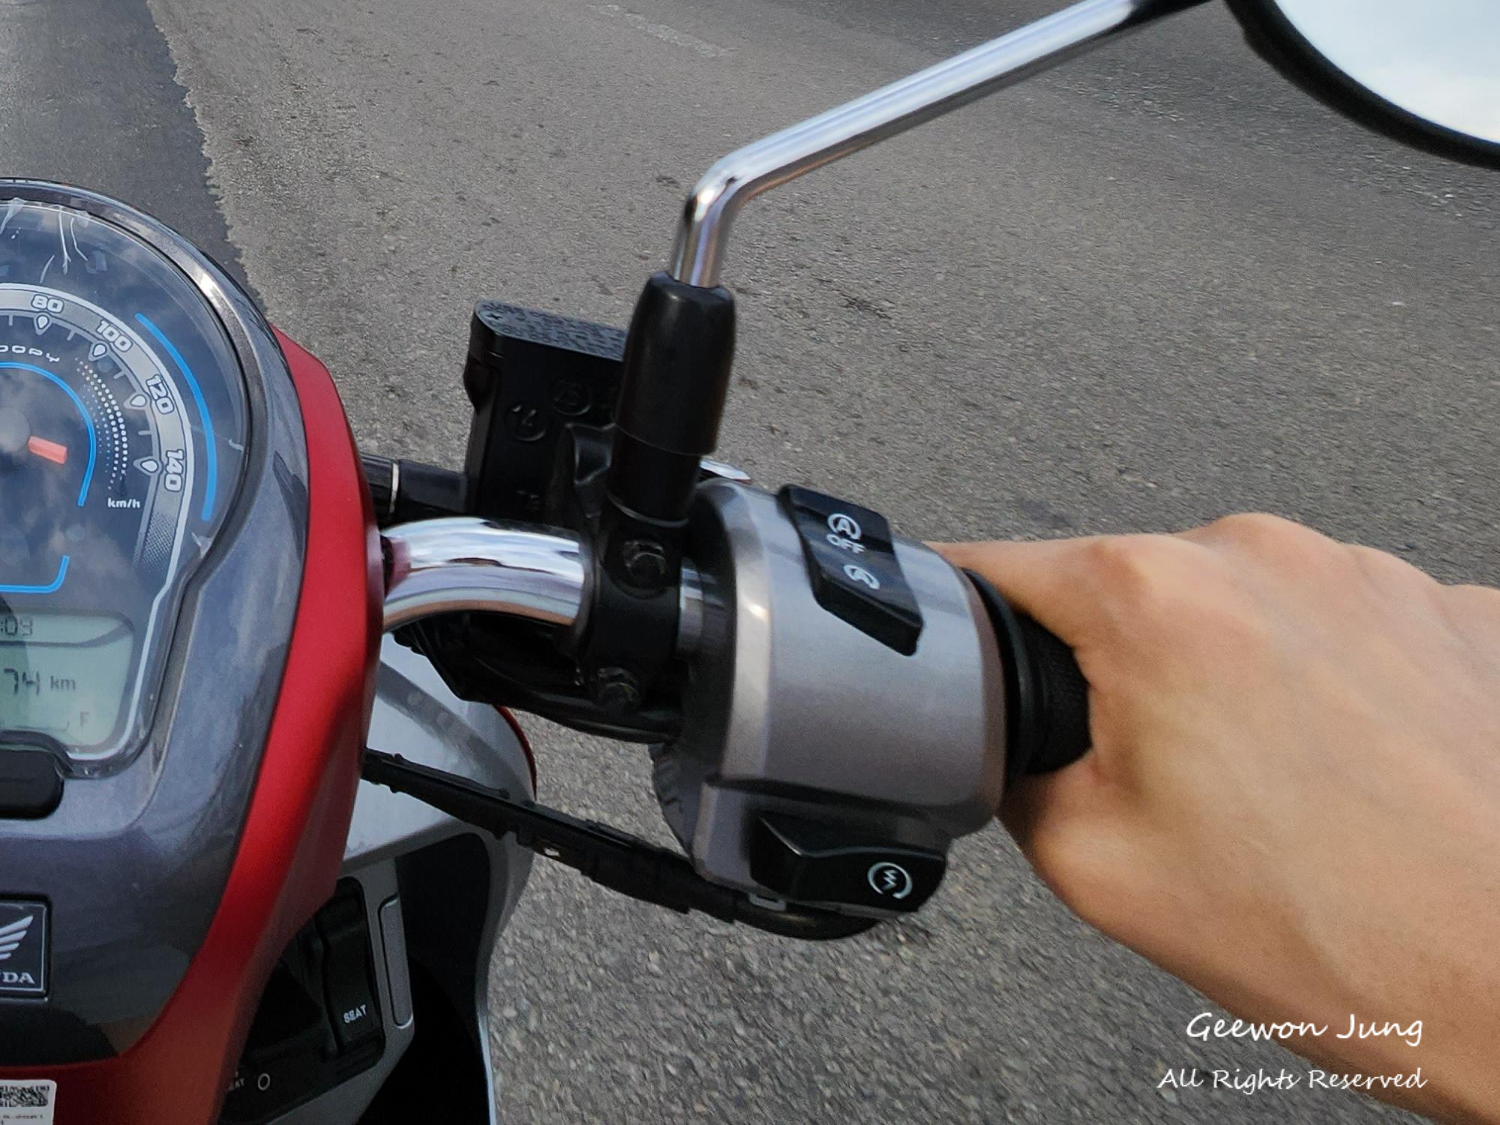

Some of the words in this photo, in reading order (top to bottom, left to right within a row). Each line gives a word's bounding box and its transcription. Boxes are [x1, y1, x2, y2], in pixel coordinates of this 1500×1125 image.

[31, 294, 64, 313] 80
[97, 319, 133, 352] 100
[146, 374, 175, 414] 120
[164, 449, 185, 492] 140
[107, 497, 141, 509] km/h
[826, 533, 866, 554] OFF
[50, 675, 76, 691] km
[343, 1004, 367, 1024] SEAT
